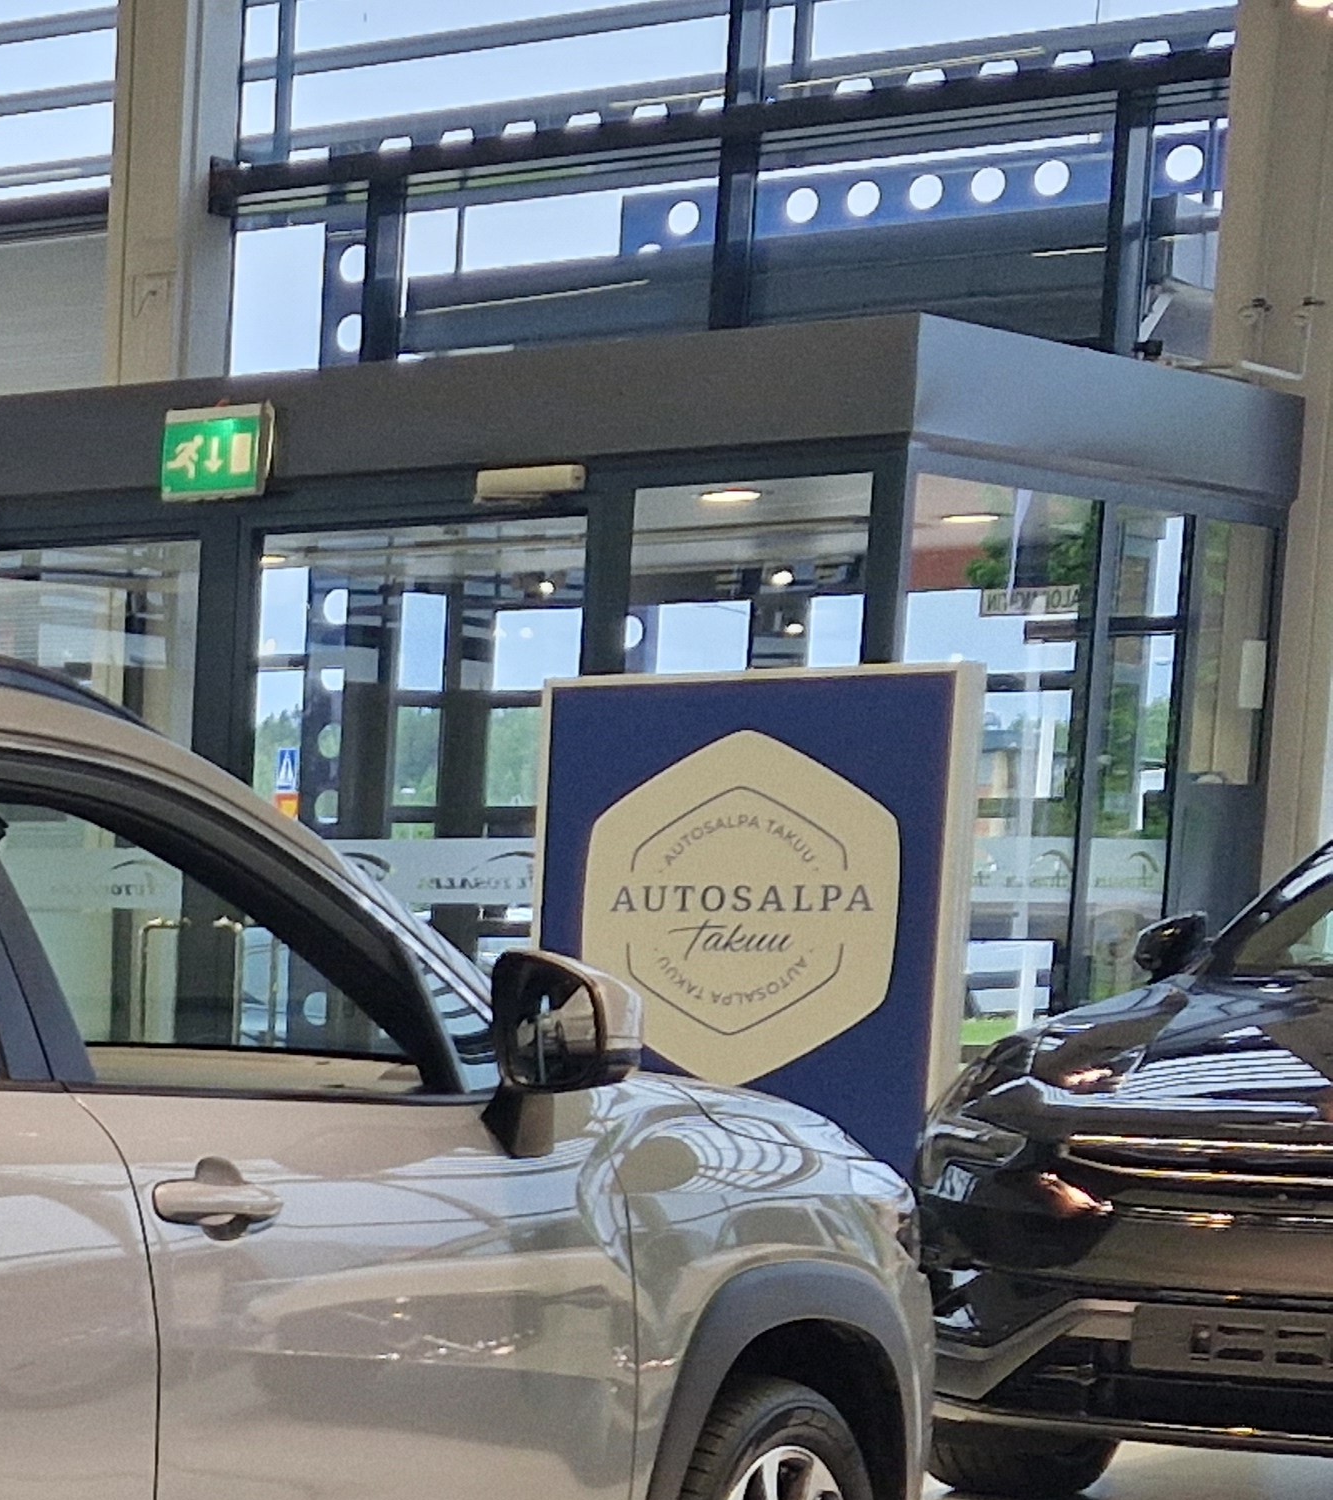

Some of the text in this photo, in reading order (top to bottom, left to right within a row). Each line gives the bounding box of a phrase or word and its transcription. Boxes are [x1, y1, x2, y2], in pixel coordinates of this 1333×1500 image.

[664, 814, 816, 866] AUTOSALPA TAKUU
[610, 884, 874, 913] AUTOSALPA
[668, 919, 794, 961] Takuu
[657, 956, 809, 1006] AUTOSALPA TAKUU
